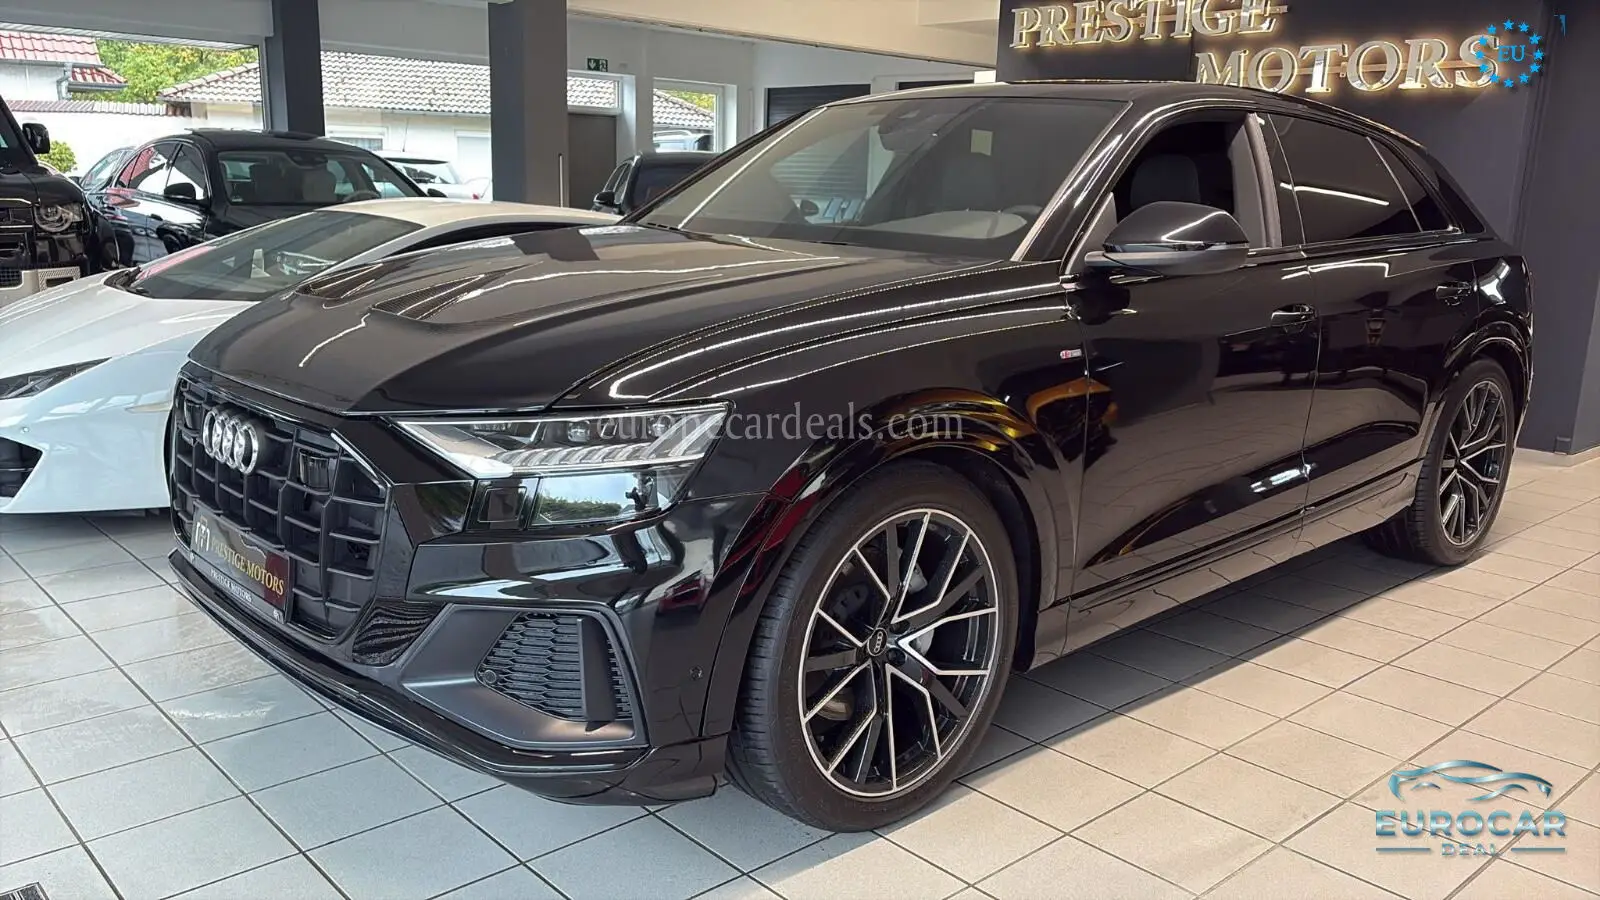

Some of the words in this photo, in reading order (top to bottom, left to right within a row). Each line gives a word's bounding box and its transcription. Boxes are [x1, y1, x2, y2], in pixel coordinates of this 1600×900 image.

[1009, 0, 1277, 49] PRESTIGE
[1195, 33, 1500, 94] MOTORS
[246, 559, 285, 596] MOTORS
